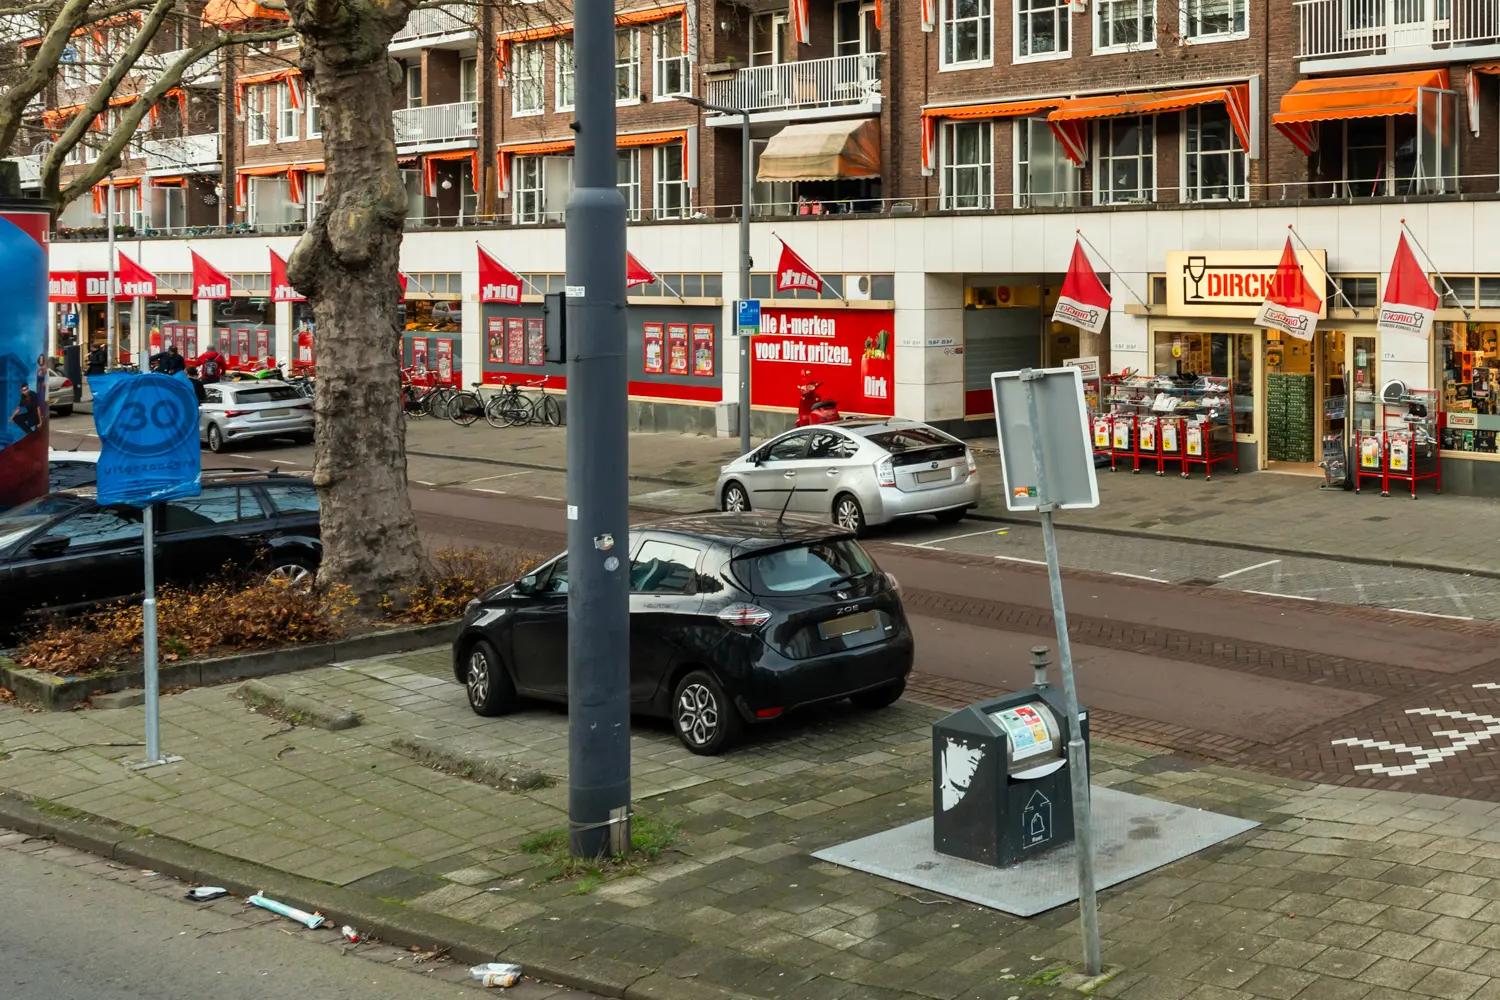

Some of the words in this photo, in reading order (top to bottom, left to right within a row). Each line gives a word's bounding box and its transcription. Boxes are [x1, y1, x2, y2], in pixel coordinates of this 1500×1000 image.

[739, 301, 748, 313] P
[779, 314, 836, 336] A-merken
[755, 342, 781, 359] voor
[782, 340, 808, 361] Dirk
[808, 341, 852, 364] prijzen.
[864, 375, 887, 397] Dirk
[119, 399, 180, 432] 30
[836, 604, 859, 615] ZOE
